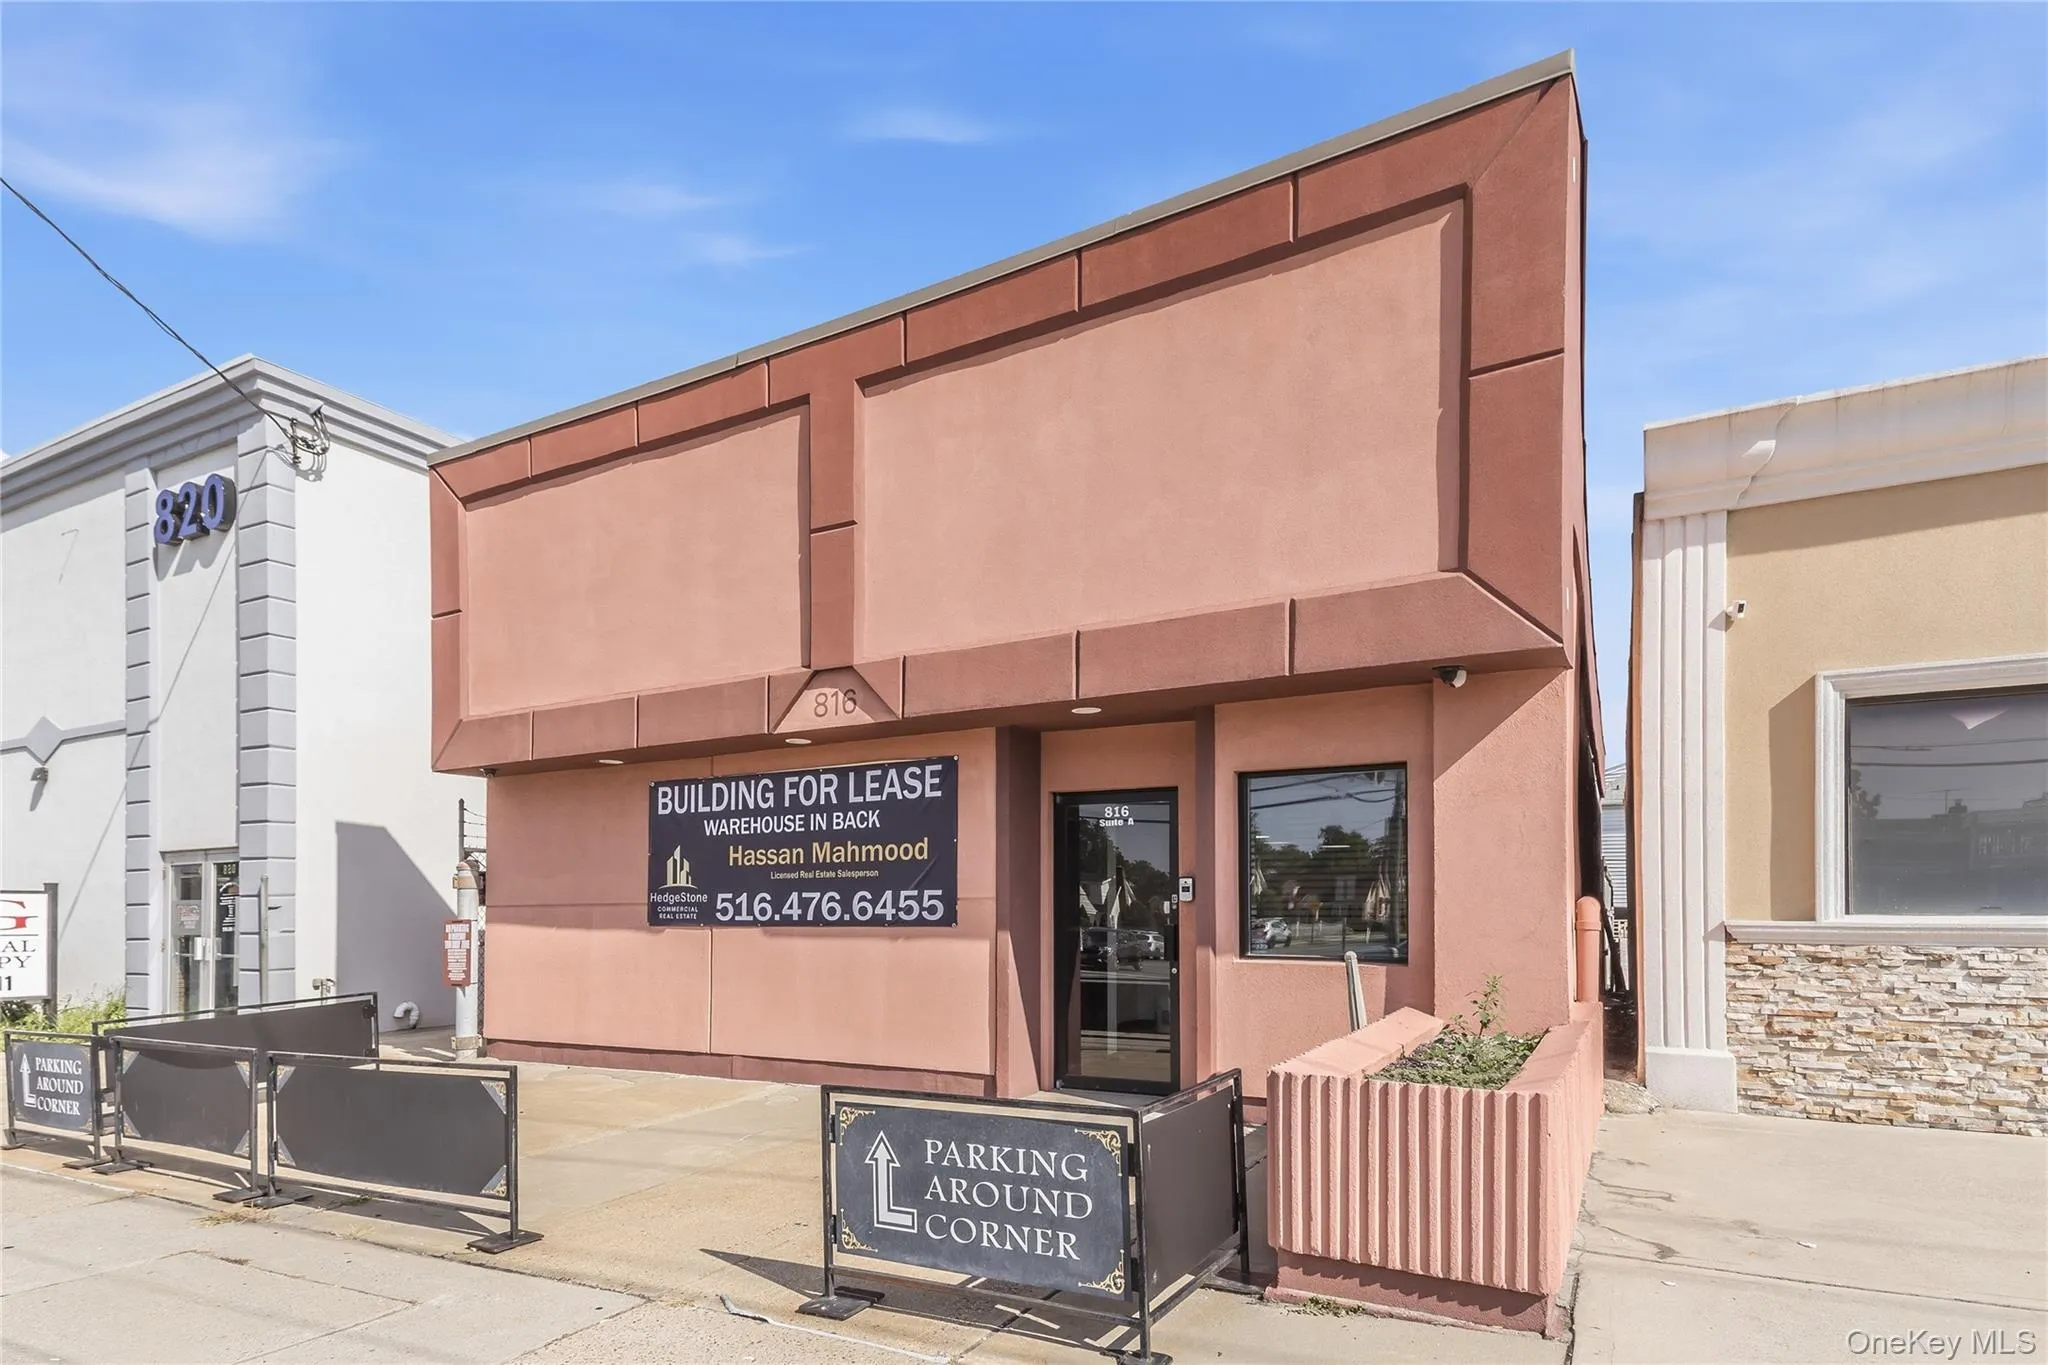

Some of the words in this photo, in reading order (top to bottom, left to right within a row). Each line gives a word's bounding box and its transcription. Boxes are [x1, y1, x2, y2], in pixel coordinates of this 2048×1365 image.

[154, 473, 235, 544] 820
[813, 688, 857, 718] 816
[657, 778, 775, 815] BUILDING
[783, 774, 839, 808] FOR
[848, 764, 943, 804] LEASE
[704, 814, 805, 836] WAREHOUSE
[810, 813, 827, 832] IN
[832, 810, 881, 831] BACK
[1099, 818, 1123, 826] Suite
[1127, 817, 1134, 825] A
[1104, 806, 1128, 817] 816
[728, 844, 805, 867] Hassan
[811, 837, 929, 864] Mahmood
[770, 871, 799, 880] Licensed
[800, 870, 815, 879] Real
[815, 870, 836, 879] Estate
[837, 869, 879, 879] Salesperson
[650, 892, 708, 905] HedgeStone
[715, 889, 944, 922] 516.476.6455
[35, 1056, 82, 1075] PARKING
[36, 1076, 84, 1095] AROUND
[37, 1096, 81, 1116] CORNER
[924, 1138, 1088, 1182] PARKING
[924, 1174, 1093, 1220] AROUND
[925, 1214, 1081, 1261] CORNER
